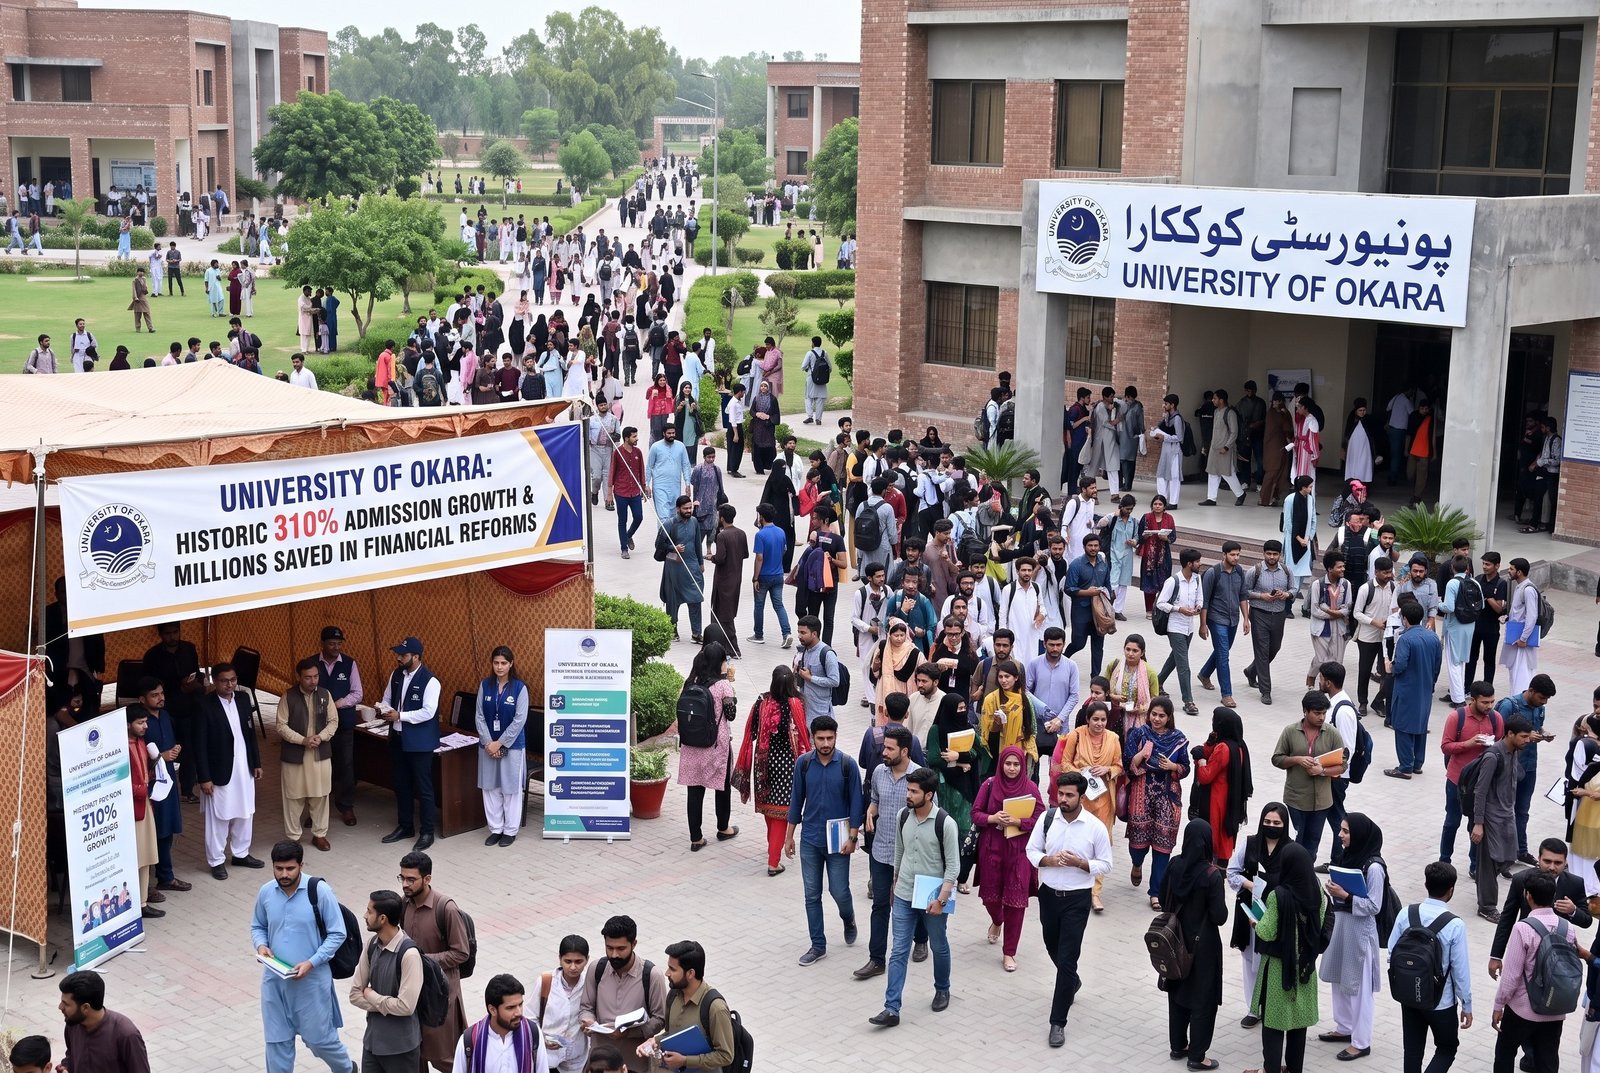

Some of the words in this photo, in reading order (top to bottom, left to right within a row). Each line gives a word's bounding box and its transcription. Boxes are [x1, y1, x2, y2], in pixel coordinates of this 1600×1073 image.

[1048, 197, 1082, 237] UNIVERSITY
[1084, 199, 1095, 209] OF
[1095, 208, 1109, 242] OKARA
[1122, 262, 1280, 300] UNIVERSITY
[1287, 274, 1327, 303] OF
[1335, 277, 1446, 313] OKARA
[220, 467, 365, 513] UNIVERSITY
[373, 463, 402, 493] OF
[410, 452, 493, 488] OKARA:
[81, 505, 118, 553] UNIVERSITY
[120, 506, 134, 516] OF
[133, 513, 151, 545] OKARA
[176, 521, 268, 556] HISTORIC
[274, 507, 339, 542] 310%
[344, 495, 442, 532] ADMISSION
[447, 487, 517, 517] GROWTH
[522, 484, 535, 506] &
[174, 552, 268, 588] MILLIONS
[273, 543, 333, 573] SAVED
[339, 539, 358, 563] IN
[363, 525, 455, 559] FINANCIAL
[459, 511, 537, 544] REFORMS
[68, 757, 97, 774] UNIVERSITY
[96, 754, 104, 762] OF
[82, 802, 117, 832] 310%
[86, 834, 116, 853] GROWTH
